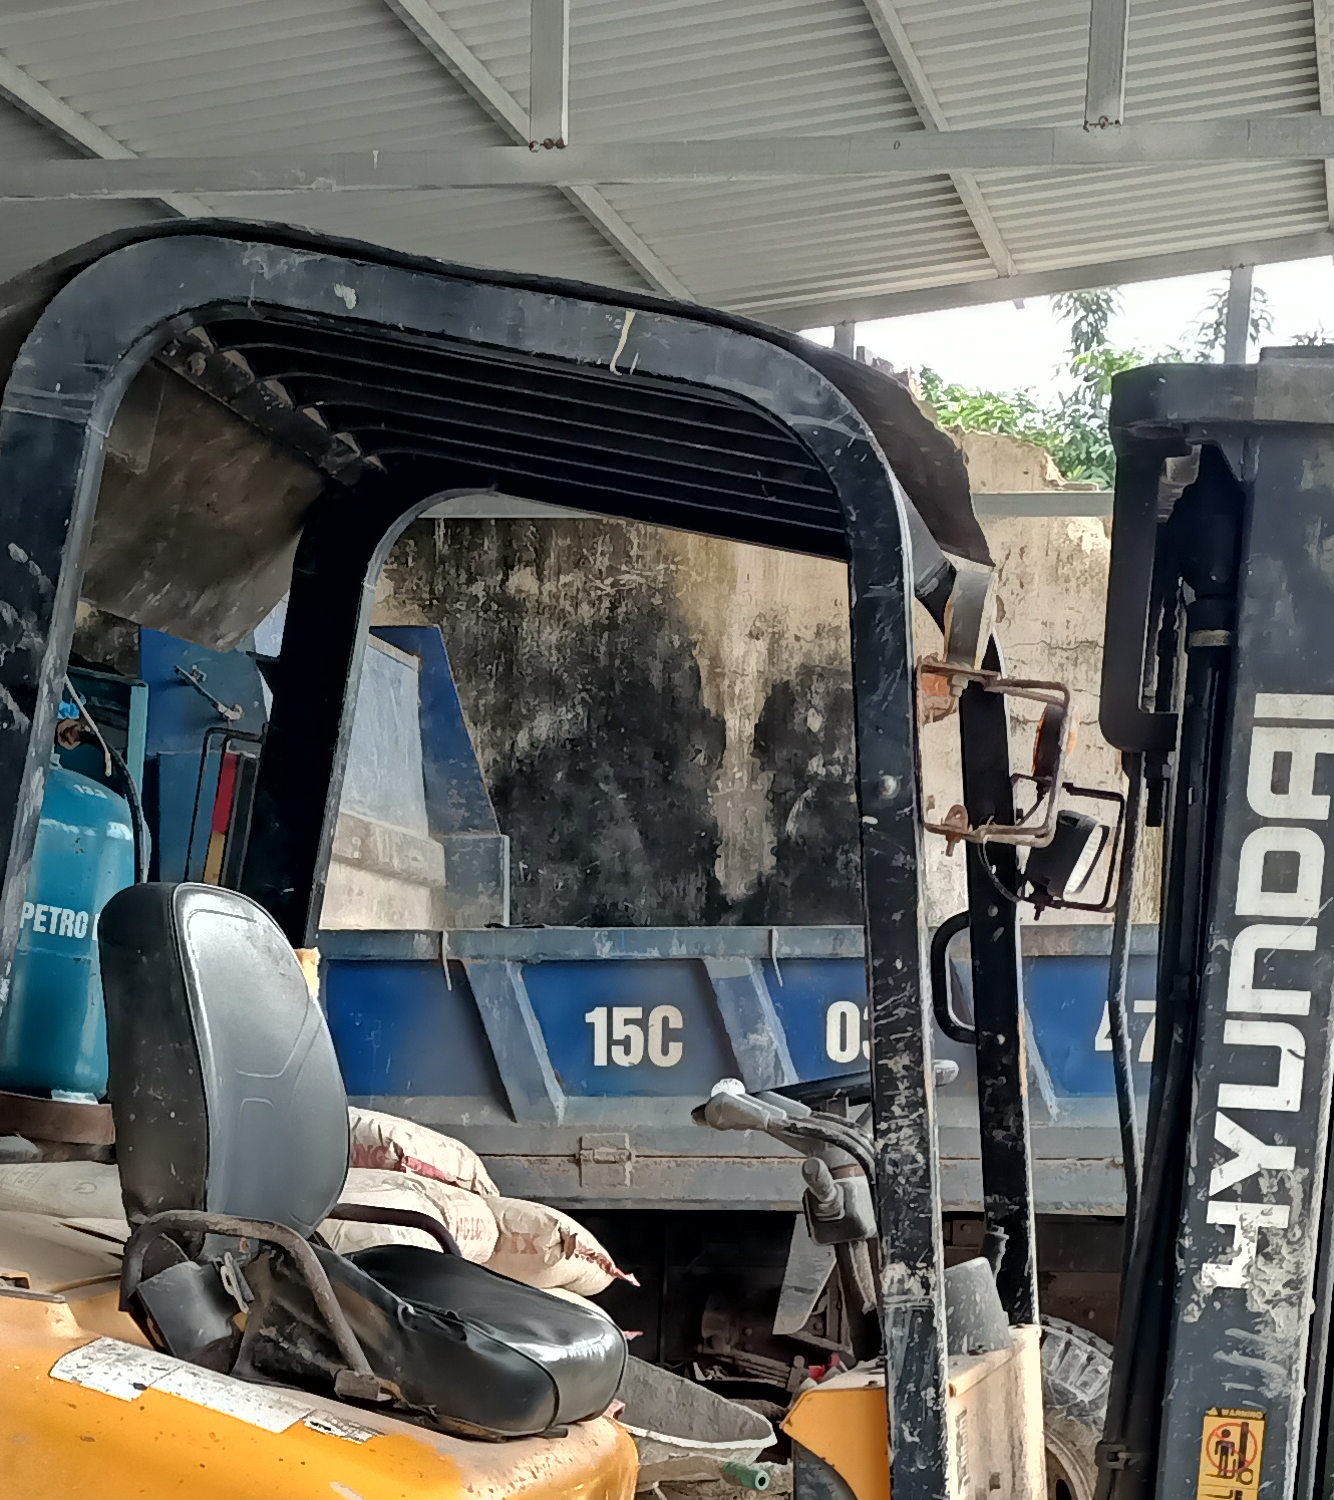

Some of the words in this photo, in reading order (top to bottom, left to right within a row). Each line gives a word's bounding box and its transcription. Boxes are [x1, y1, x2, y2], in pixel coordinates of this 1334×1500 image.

[20, 901, 88, 939] PETRO
[585, 1004, 684, 1068] 15C
[826, 1000, 872, 1064] 0
[1222, 1408, 1265, 1420] WARNING
